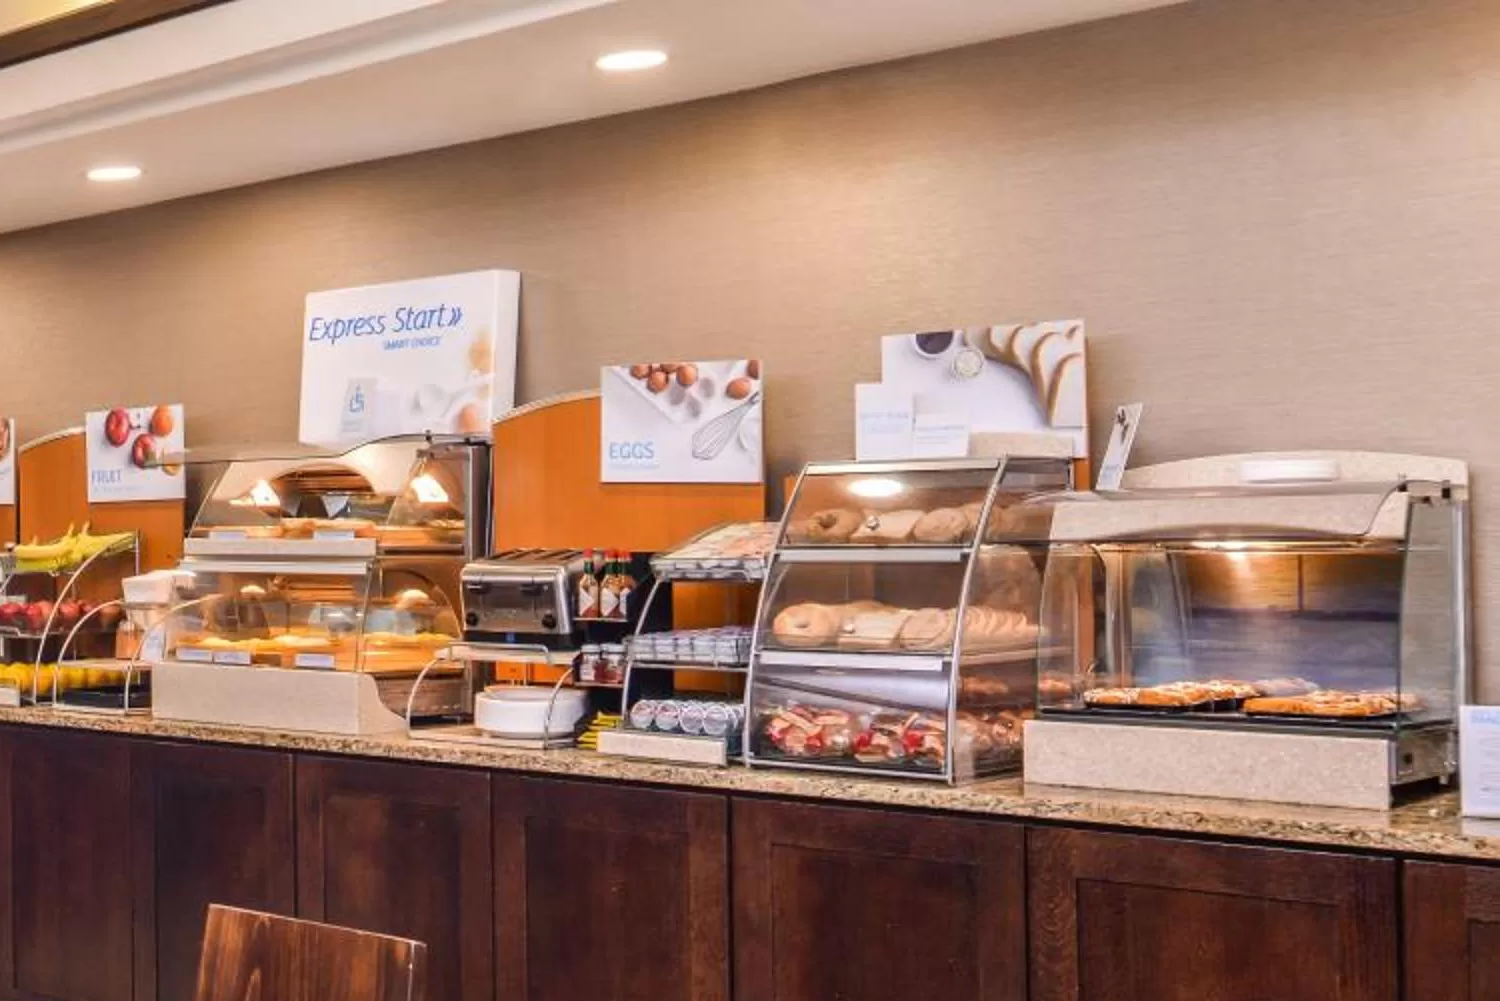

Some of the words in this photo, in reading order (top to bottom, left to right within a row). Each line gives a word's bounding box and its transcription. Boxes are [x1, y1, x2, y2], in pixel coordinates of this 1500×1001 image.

[309, 315, 386, 344] Express
[609, 442, 655, 460] EGGS
[91, 469, 121, 484] FRUIT
